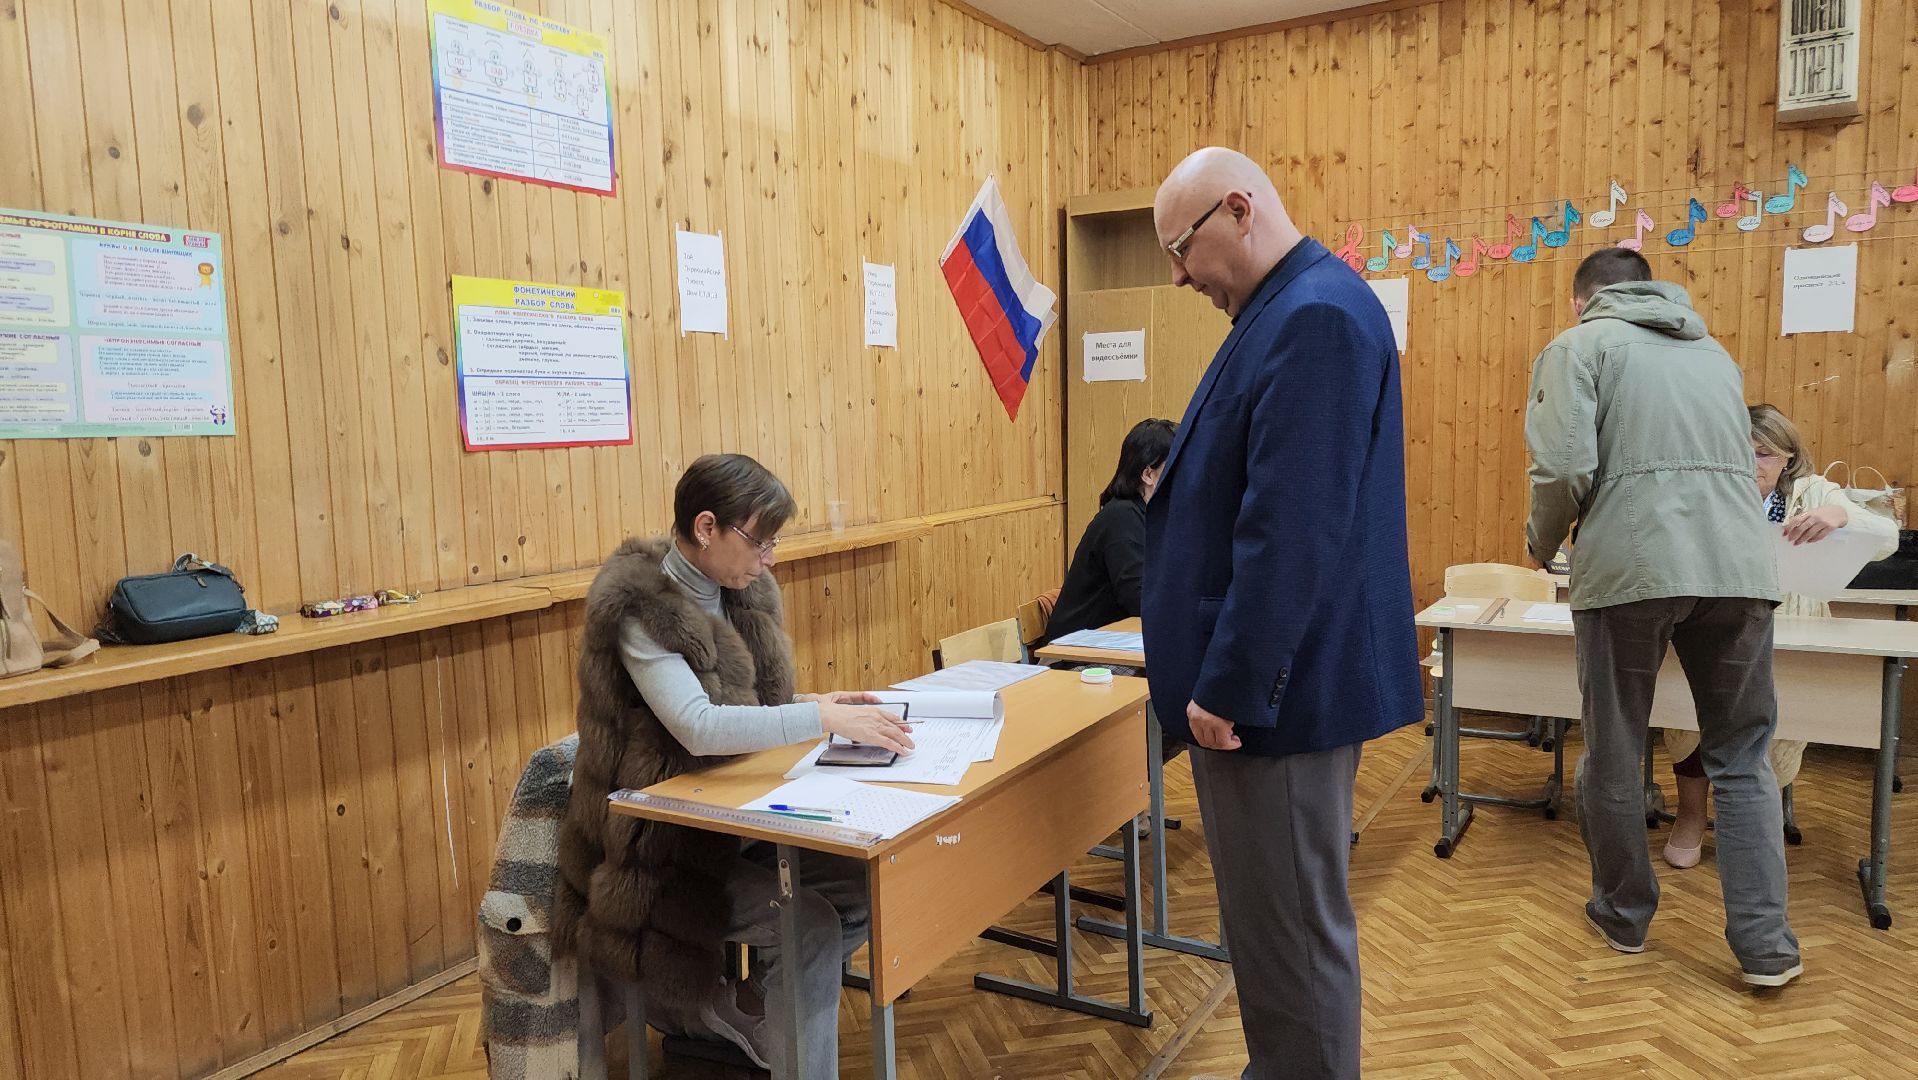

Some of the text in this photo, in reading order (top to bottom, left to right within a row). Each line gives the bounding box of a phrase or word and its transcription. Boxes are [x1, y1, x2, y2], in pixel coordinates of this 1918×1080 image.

[474, 0, 501, 13] РАЗБОР
[504, 8, 526, 21] СЛОВА
[29, 219, 98, 234] ОРФОГРАММЫ
[100, 227, 106, 235] В
[107, 228, 137, 238] КОРНЕ
[138, 231, 167, 242] СЛОВА
[513, 286, 576, 299] ФОНЕТИЧЕСКИЙ
[514, 298, 575, 310] РАЗБОР СЛОВА
[1095, 341, 1132, 350] Места для
